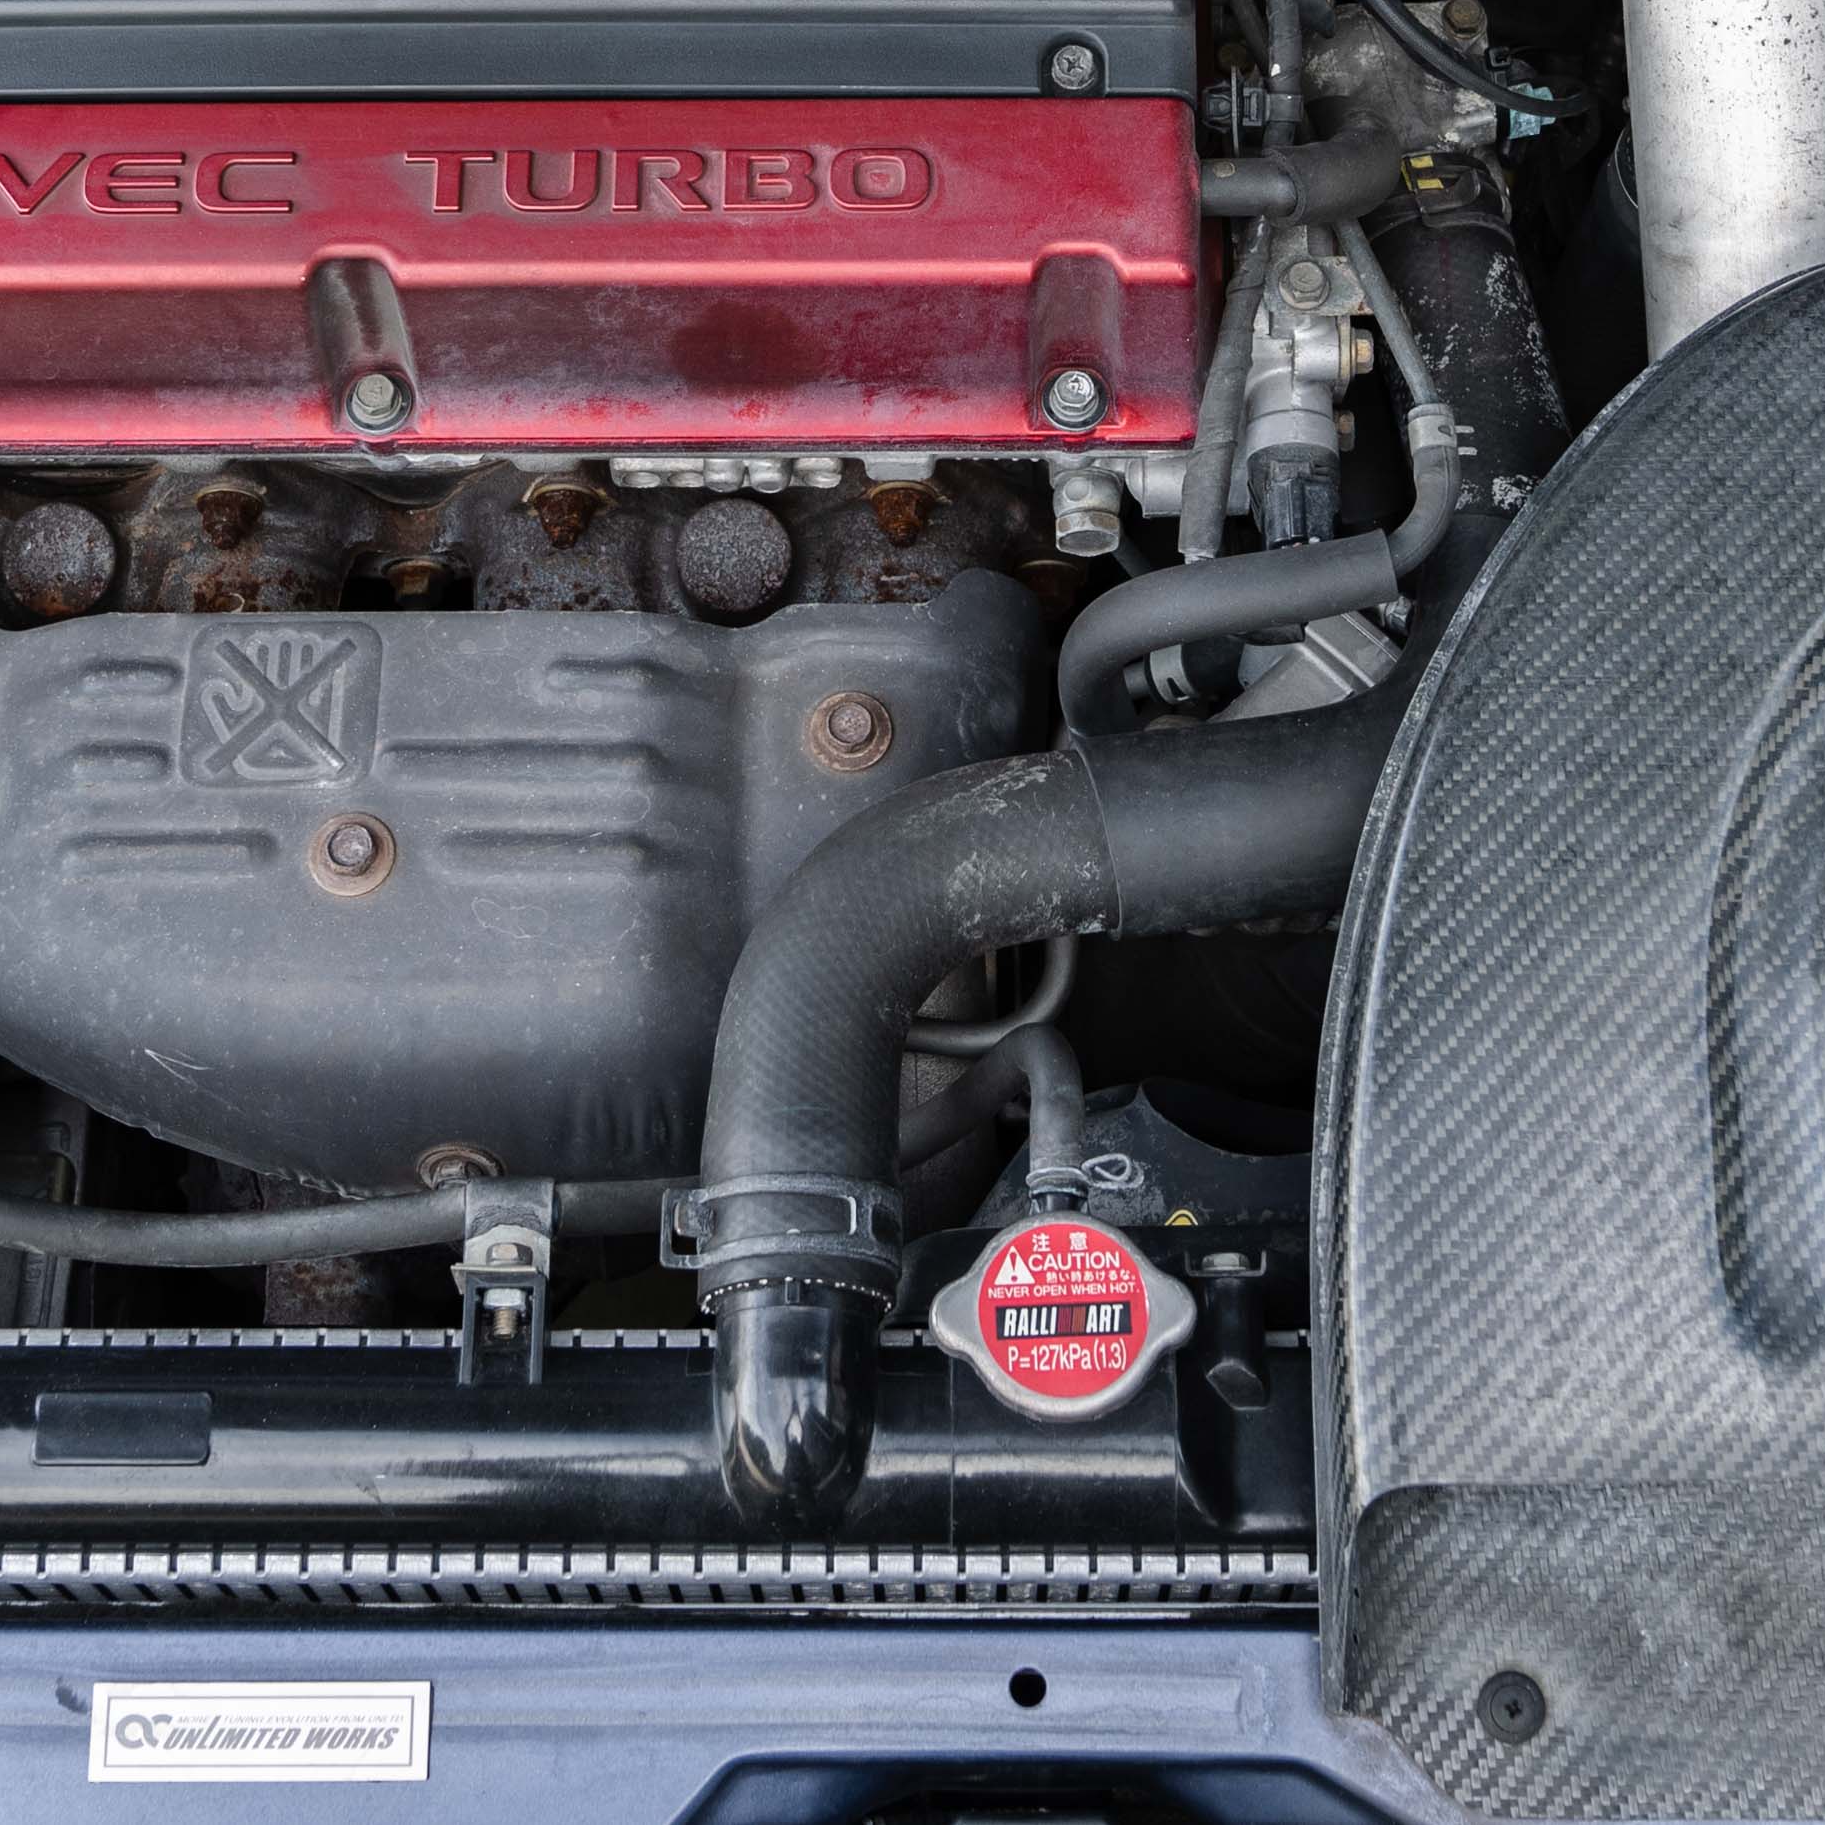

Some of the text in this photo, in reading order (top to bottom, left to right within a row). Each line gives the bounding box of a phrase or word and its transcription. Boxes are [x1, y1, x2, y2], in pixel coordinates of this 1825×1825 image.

[404, 146, 936, 216] TURBO
[1031, 1231, 1089, 1253] 注意
[1028, 1251, 1121, 1272] CAUTION
[987, 1281, 1141, 1300] NEVER OPEN WHEN HOT.
[1003, 1303, 1124, 1338] RALLI ART
[162, 1714, 400, 1751] UNLIMITED WORKS
